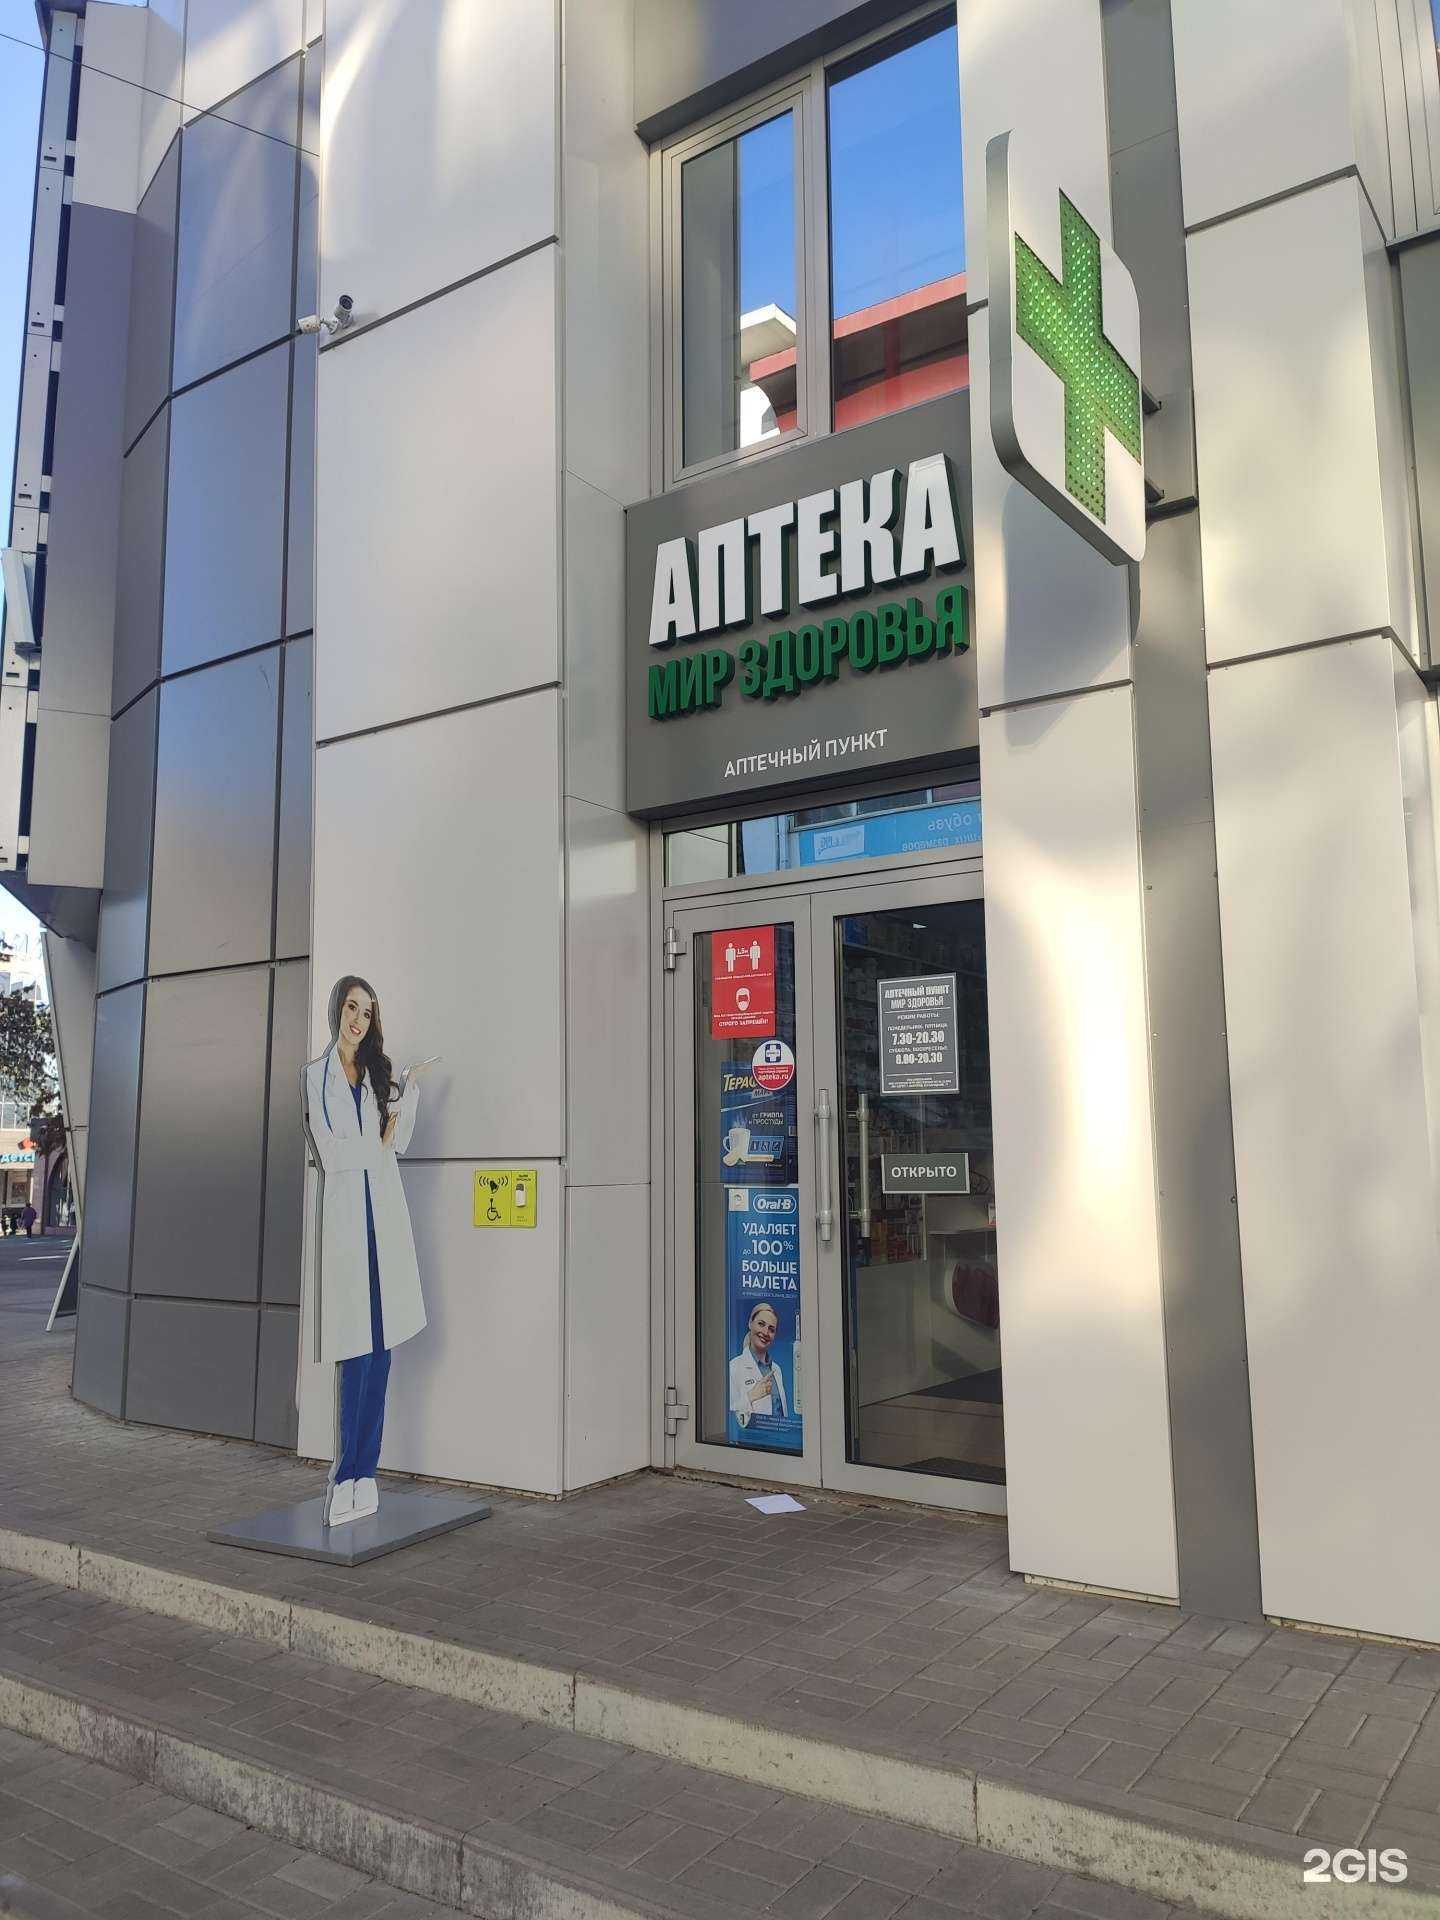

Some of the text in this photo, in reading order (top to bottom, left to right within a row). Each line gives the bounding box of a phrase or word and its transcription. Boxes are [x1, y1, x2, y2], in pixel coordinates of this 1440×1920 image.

[649, 452, 966, 649] АПТЕКА
[648, 584, 970, 719] МИР ЗДОРОВЬЯ
[724, 728, 888, 778] АПТЕЧНЫЙ ПУНКТ
[885, 986, 925, 998] АПТЕЧНЫЙ
[891, 996, 944, 1009] МИР ЗДОРОВЬЯ
[892, 1030, 945, 1045] 7.30-20.30
[758, 1071, 789, 1081] apteka.ru
[891, 1166, 957, 1178] ОТКРЫТО
[757, 1198, 792, 1210] Oral-B
[742, 1222, 797, 1236] УДАЛЯЕТ
[752, 1240, 794, 1255] 100%
[742, 1260, 797, 1274] БОЛЬШЕ
[742, 1275, 798, 1291] НАЛЕТА
